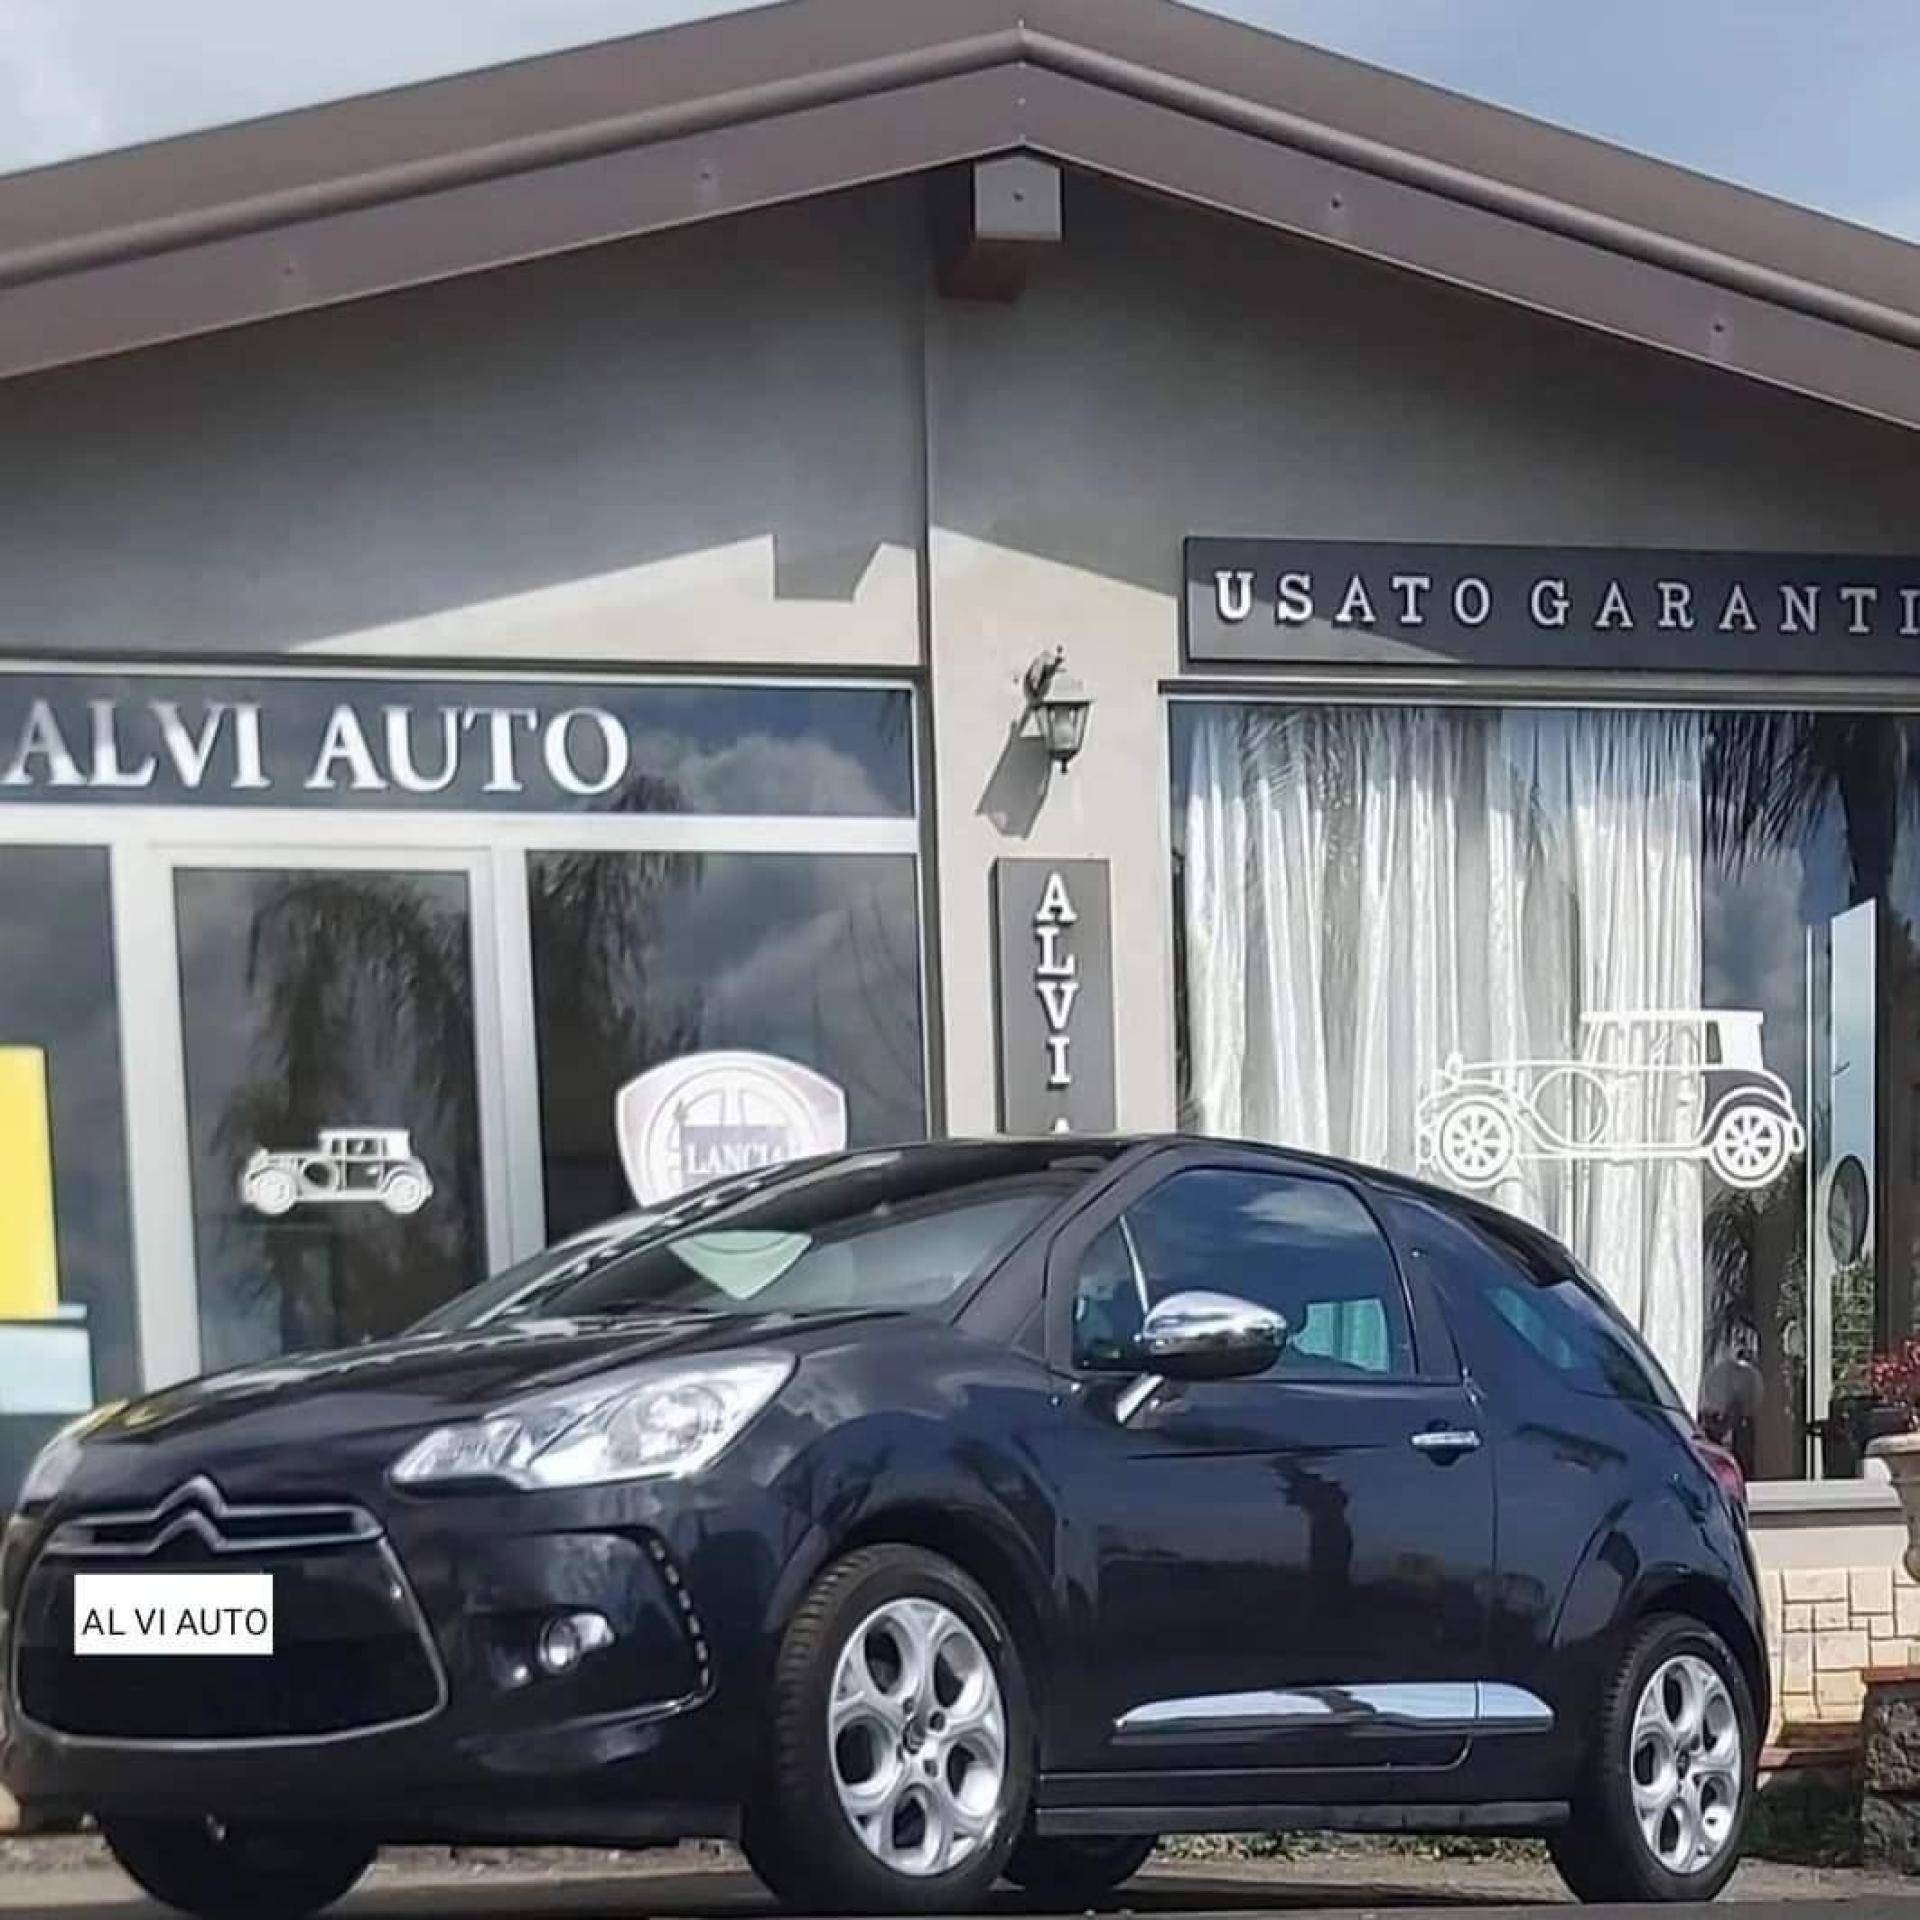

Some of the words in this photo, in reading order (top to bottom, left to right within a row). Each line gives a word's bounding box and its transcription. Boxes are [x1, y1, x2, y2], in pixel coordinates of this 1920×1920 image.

[1214, 571, 1491, 625] USATO
[1530, 579, 1920, 635] GARANTI
[2, 698, 271, 788] ALVI
[304, 705, 630, 795] AUTO
